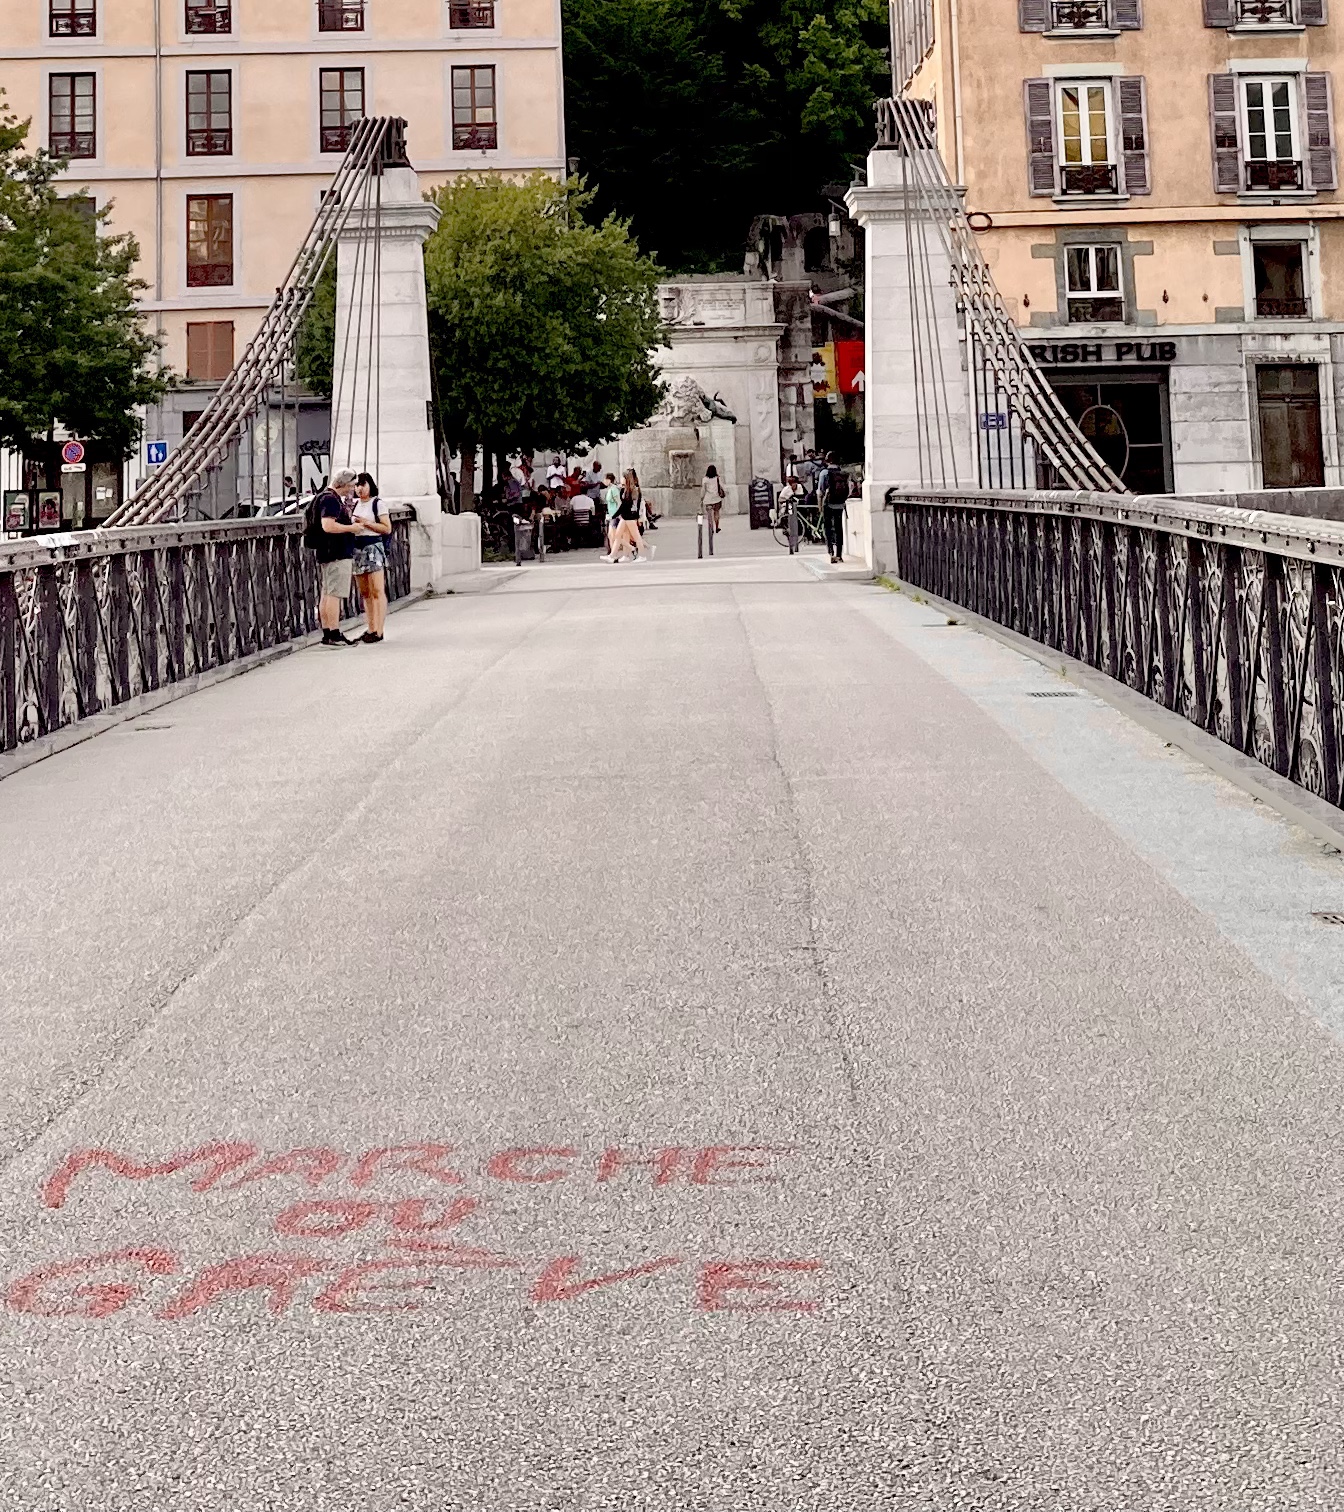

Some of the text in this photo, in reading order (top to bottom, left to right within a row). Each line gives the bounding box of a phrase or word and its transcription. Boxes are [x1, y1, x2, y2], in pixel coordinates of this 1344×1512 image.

[1115, 341, 1177, 362] PUB
[40, 1140, 791, 1208] MARCHE
[274, 1197, 476, 1237] OU
